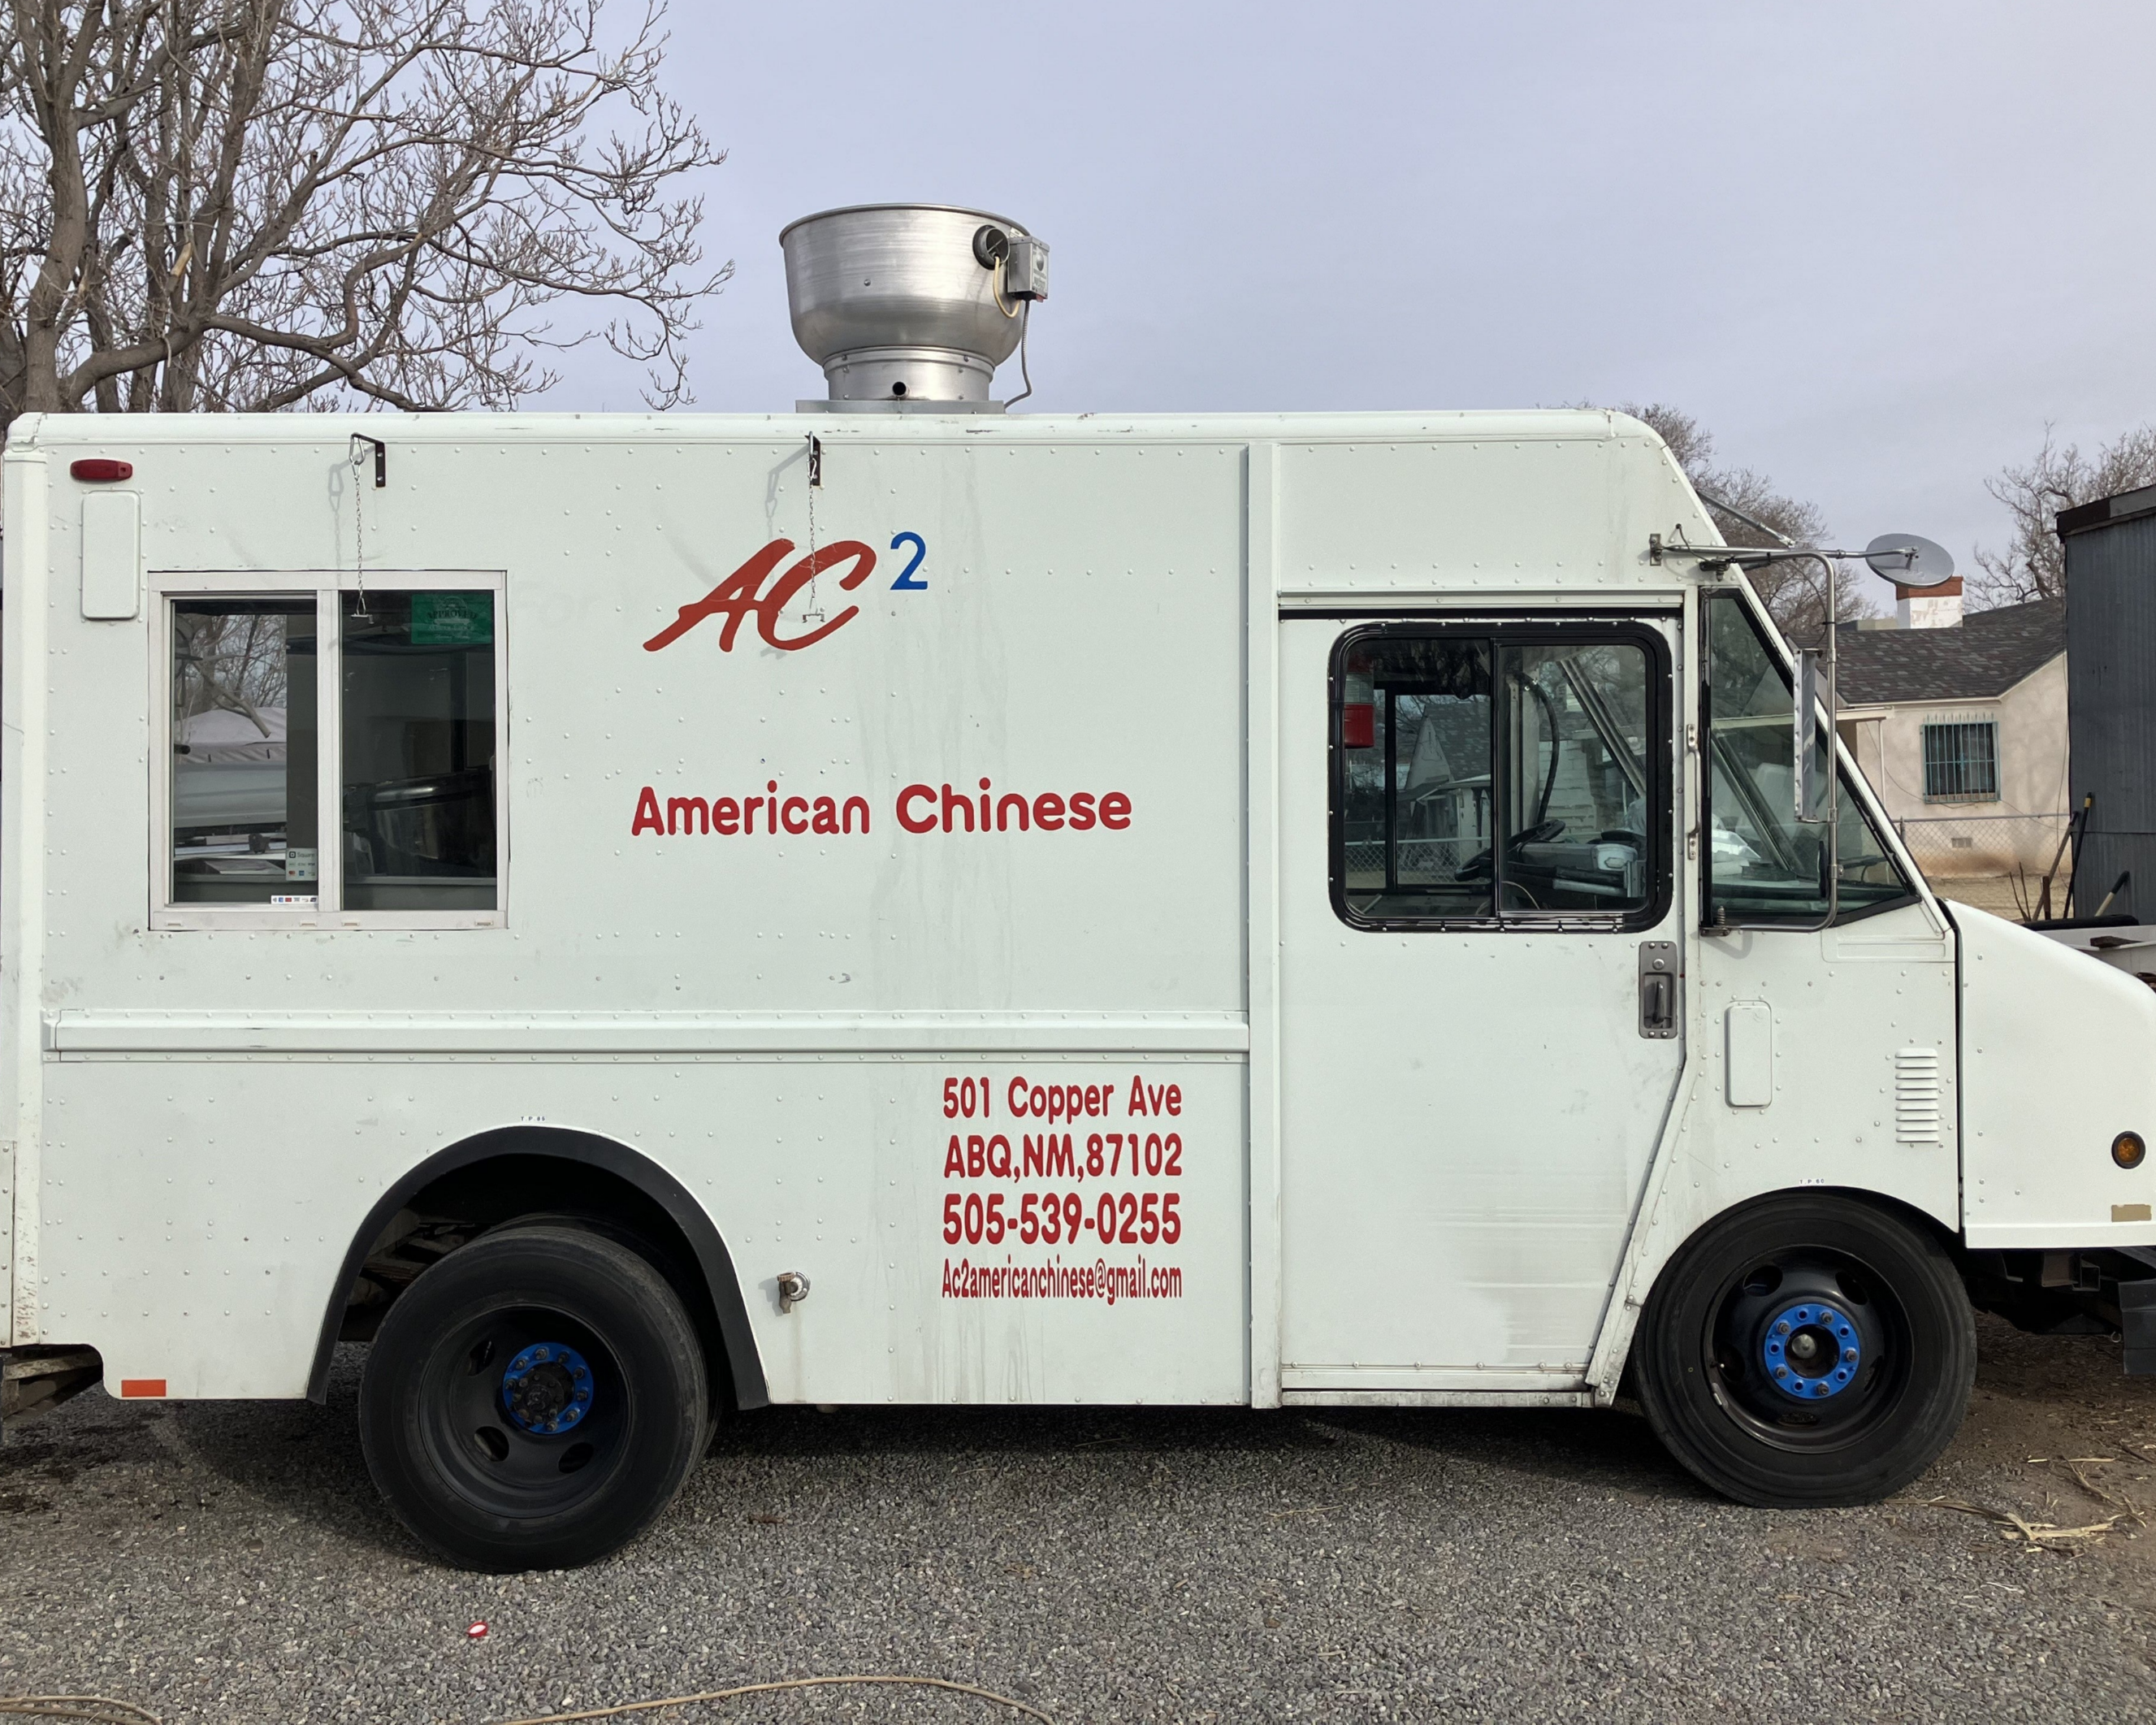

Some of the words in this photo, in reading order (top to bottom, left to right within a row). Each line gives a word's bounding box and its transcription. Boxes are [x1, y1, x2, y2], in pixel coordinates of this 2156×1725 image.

[643, 538, 877, 652] AC
[631, 779, 871, 837] American
[896, 777, 1132, 834] Chinese
[943, 1077, 990, 1119] 501
[1007, 1076, 1115, 1125] Copper
[1128, 1075, 1182, 1116] Ave
[943, 1132, 1183, 1183] ABQ,NM,87102
[942, 1192, 1182, 1245] 505-539-0255
[942, 1254, 1183, 1306] Ac2americanchinese@gmail.com
